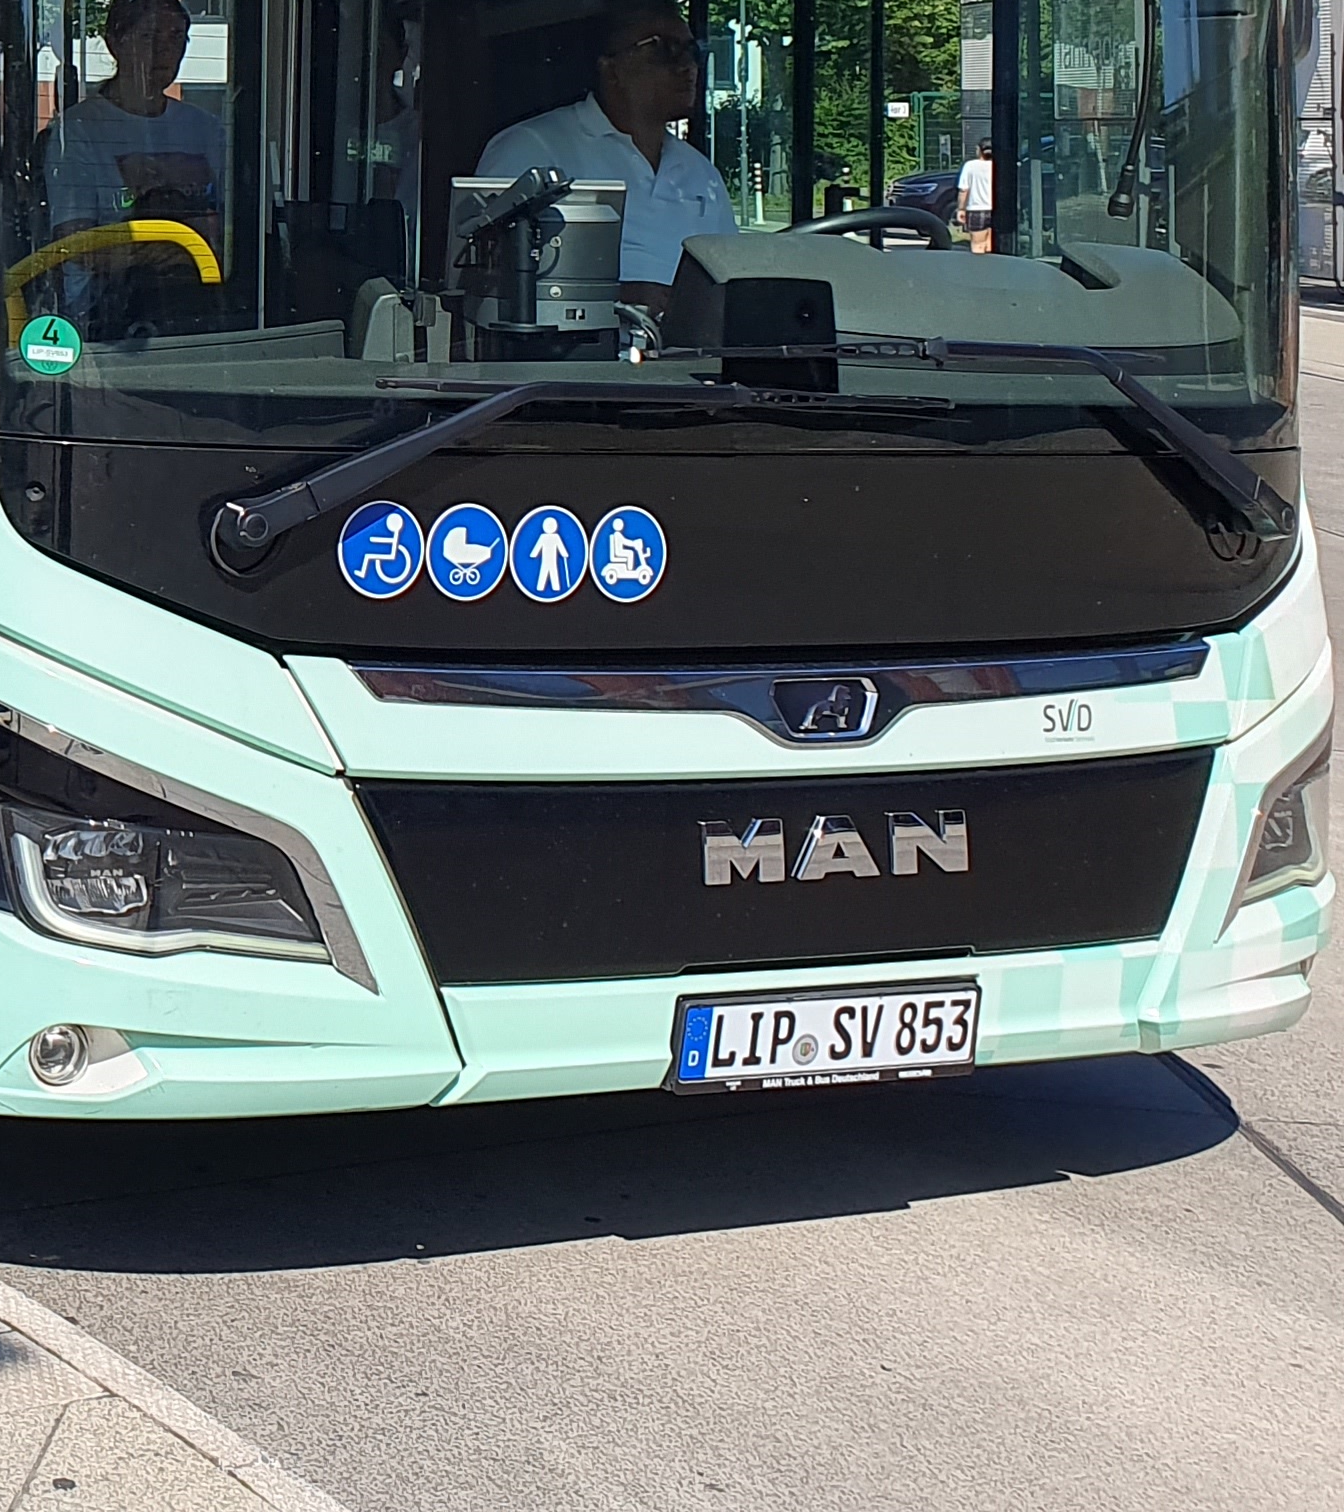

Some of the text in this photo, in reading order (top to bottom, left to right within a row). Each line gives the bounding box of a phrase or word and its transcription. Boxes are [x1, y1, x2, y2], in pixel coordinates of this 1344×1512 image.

[42, 318, 60, 345] 4
[1042, 698, 1093, 733] SVD
[696, 808, 970, 886] MAN
[90, 869, 123, 877] MAN
[687, 997, 973, 1068] D LIP SV 853
[762, 1071, 881, 1089] MAN Truck & Bus Deutschland
